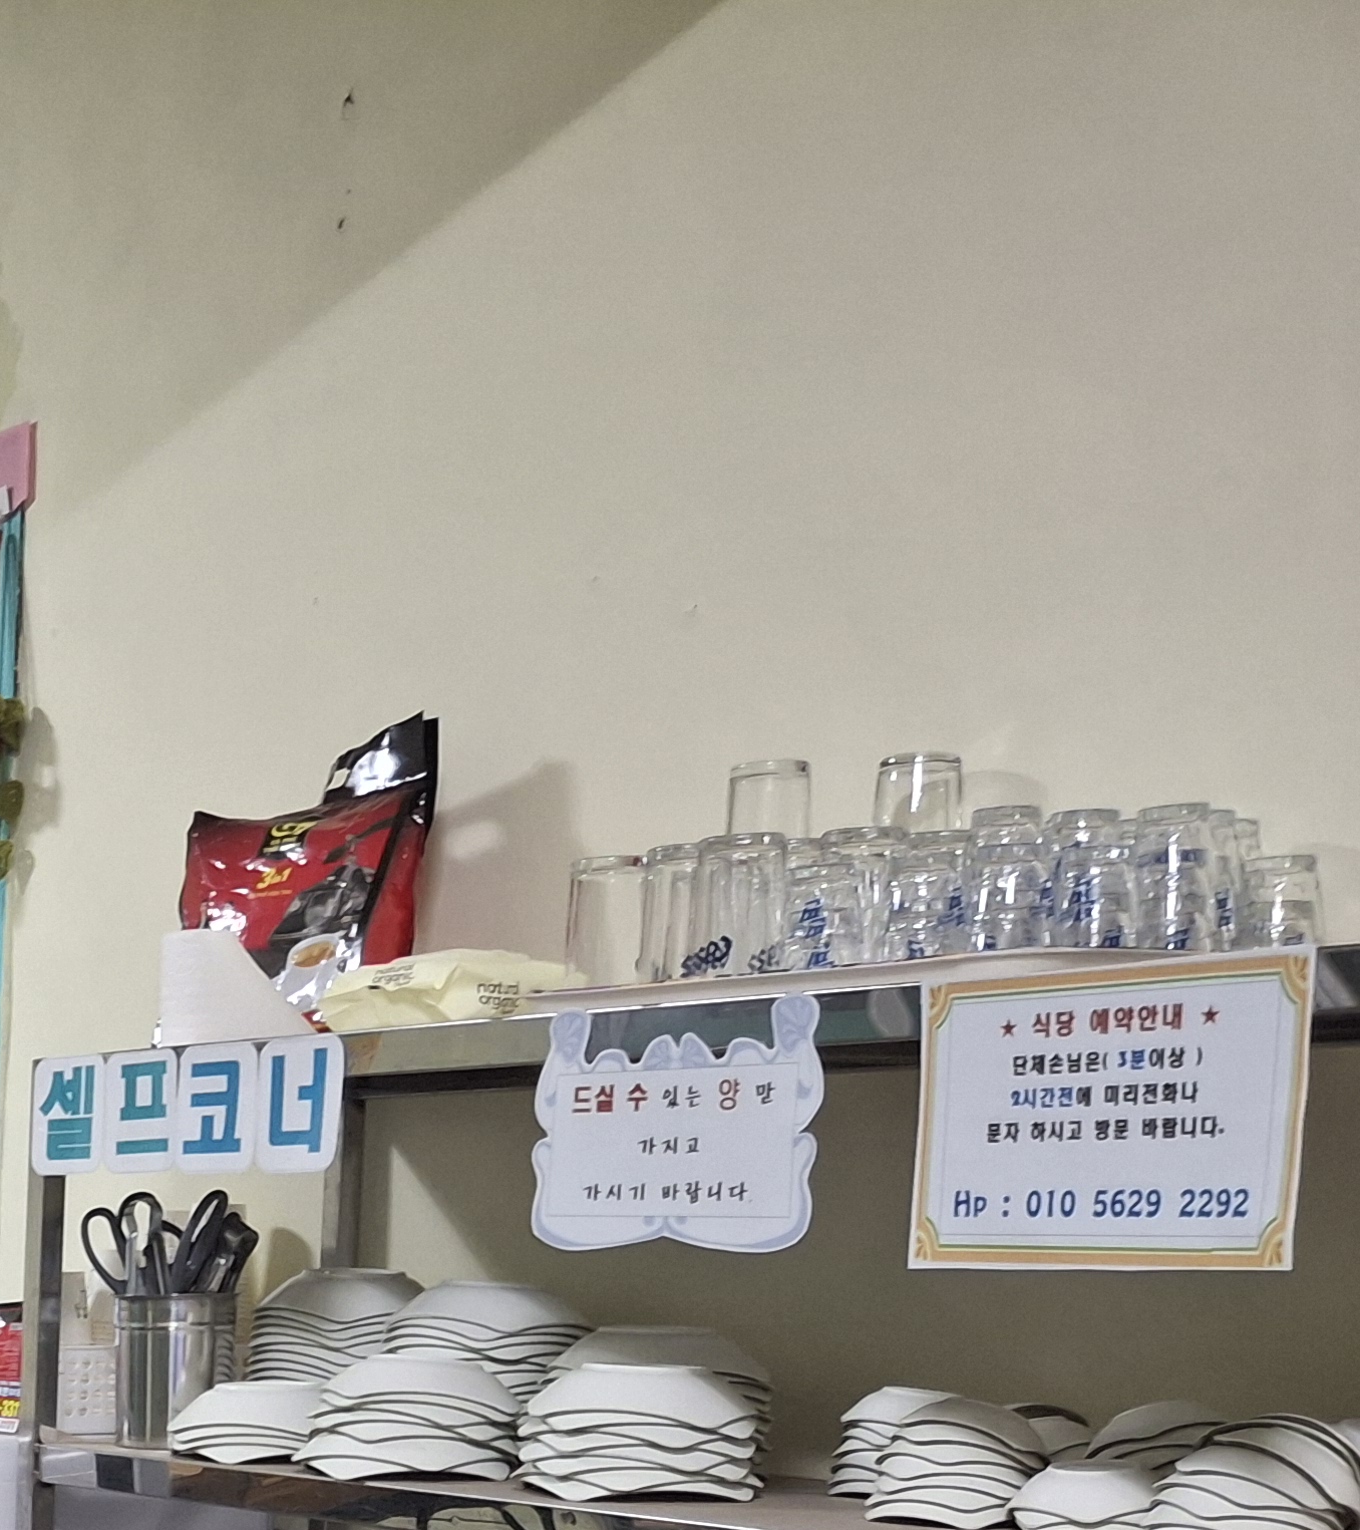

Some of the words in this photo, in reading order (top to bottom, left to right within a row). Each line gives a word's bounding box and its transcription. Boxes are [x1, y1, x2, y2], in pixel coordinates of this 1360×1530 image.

[1031, 1010, 1076, 1038] 식당
[1090, 1002, 1184, 1034] 예약안내
[39, 1047, 329, 1161] 셀프코너
[572, 1084, 615, 1113] 드실
[627, 1083, 648, 1112] 수
[662, 1085, 701, 1109] 있는
[719, 1078, 741, 1111] 양
[1010, 1085, 1092, 1109] 2시간전에
[1104, 1081, 1199, 1107] 미리전화나
[987, 1122, 1020, 1144] 문자
[1030, 1120, 1082, 1143] 하시고
[1094, 1118, 1129, 1140] 방문
[1141, 1115, 1225, 1139] 바랍니다.
[637, 1136, 700, 1155] 가지고
[583, 1183, 646, 1201] 가시기
[953, 1189, 988, 1218] Hp
[1025, 1189, 1076, 1218] 010
[1092, 1188, 1162, 1218] 5629
[1178, 1188, 1250, 1218] 2292
